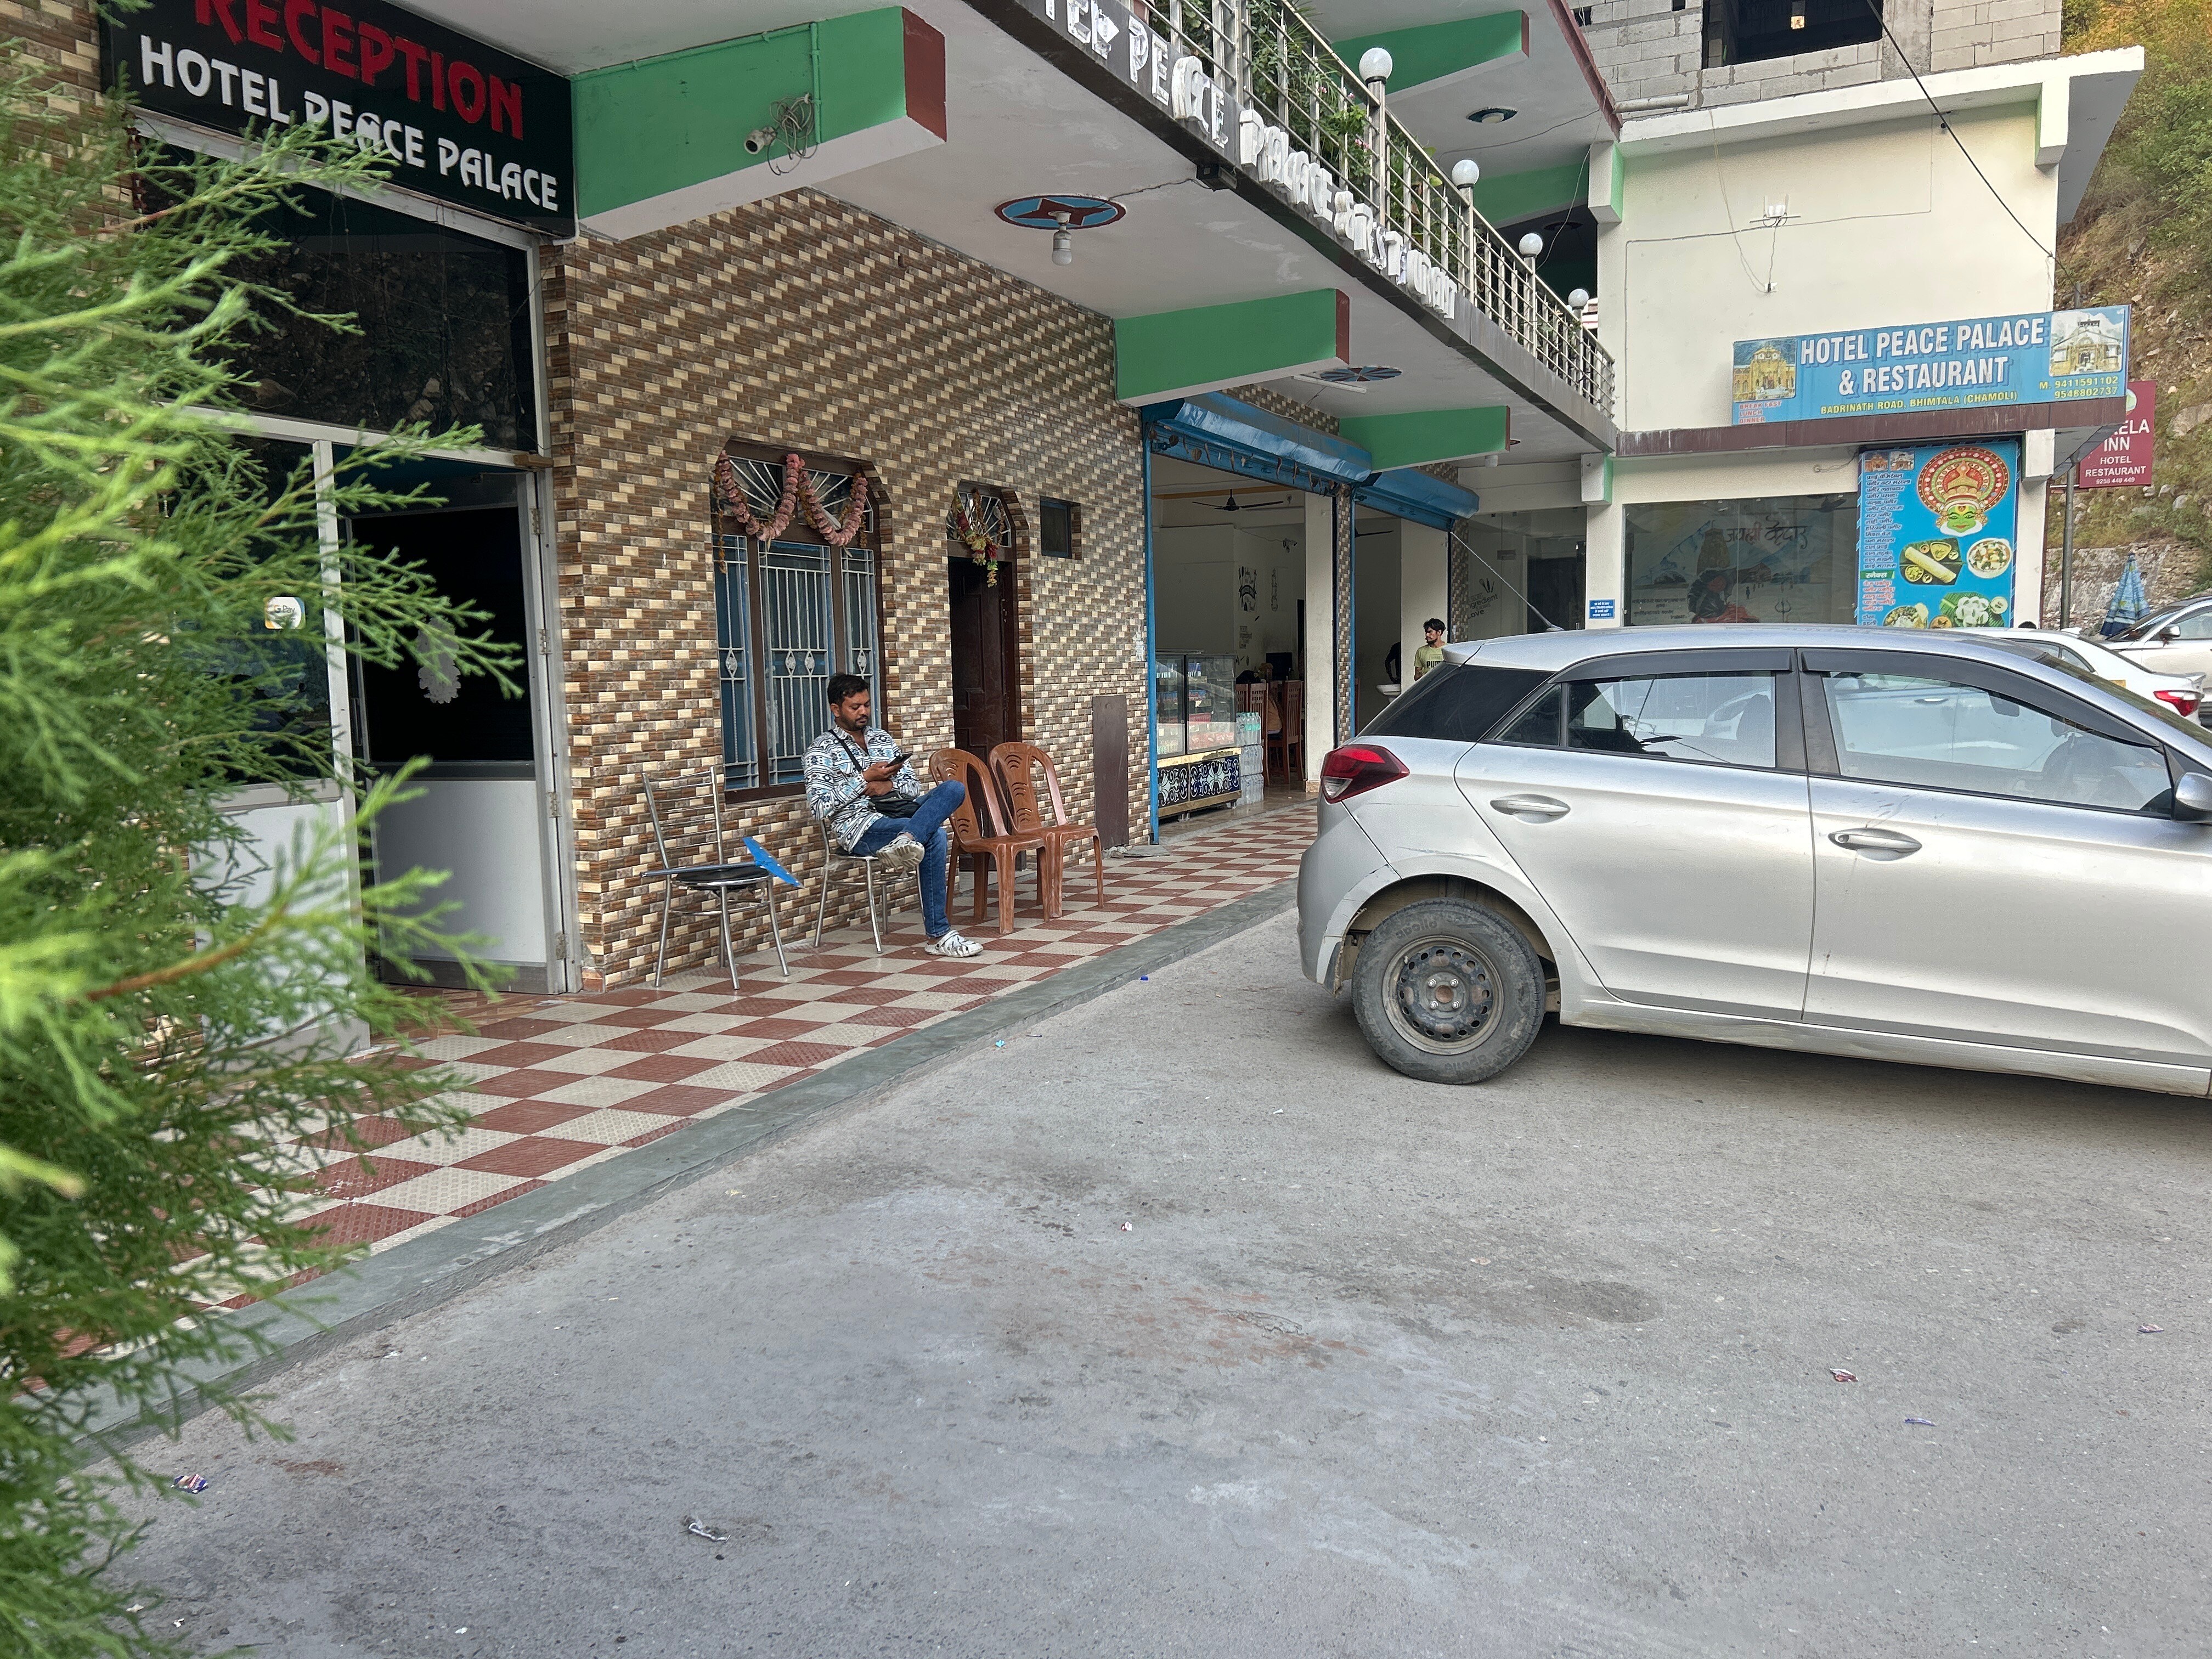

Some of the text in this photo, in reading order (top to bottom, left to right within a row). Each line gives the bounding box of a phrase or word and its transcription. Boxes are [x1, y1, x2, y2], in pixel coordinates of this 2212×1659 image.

[140, 35, 558, 212] HOTEL PEACE PALACE
[1801, 317, 2045, 365] HOTEL PEACE PALACE
[1839, 356, 2008, 396] & RESTAURANT
[2055, 376, 2119, 389] 9411591102
[2054, 386, 2118, 399] 9548802737
[1820, 391, 2018, 415] BADRINATH ROAD, BHIMTALA (CHAMOLI)
[2114, 419, 2150, 436] ELA
[2103, 436, 2130, 452] INN
[2100, 455, 2132, 465] HOTEL
[2085, 465, 2147, 477] RESTAURANT
[283, 605, 296, 613] Pay
